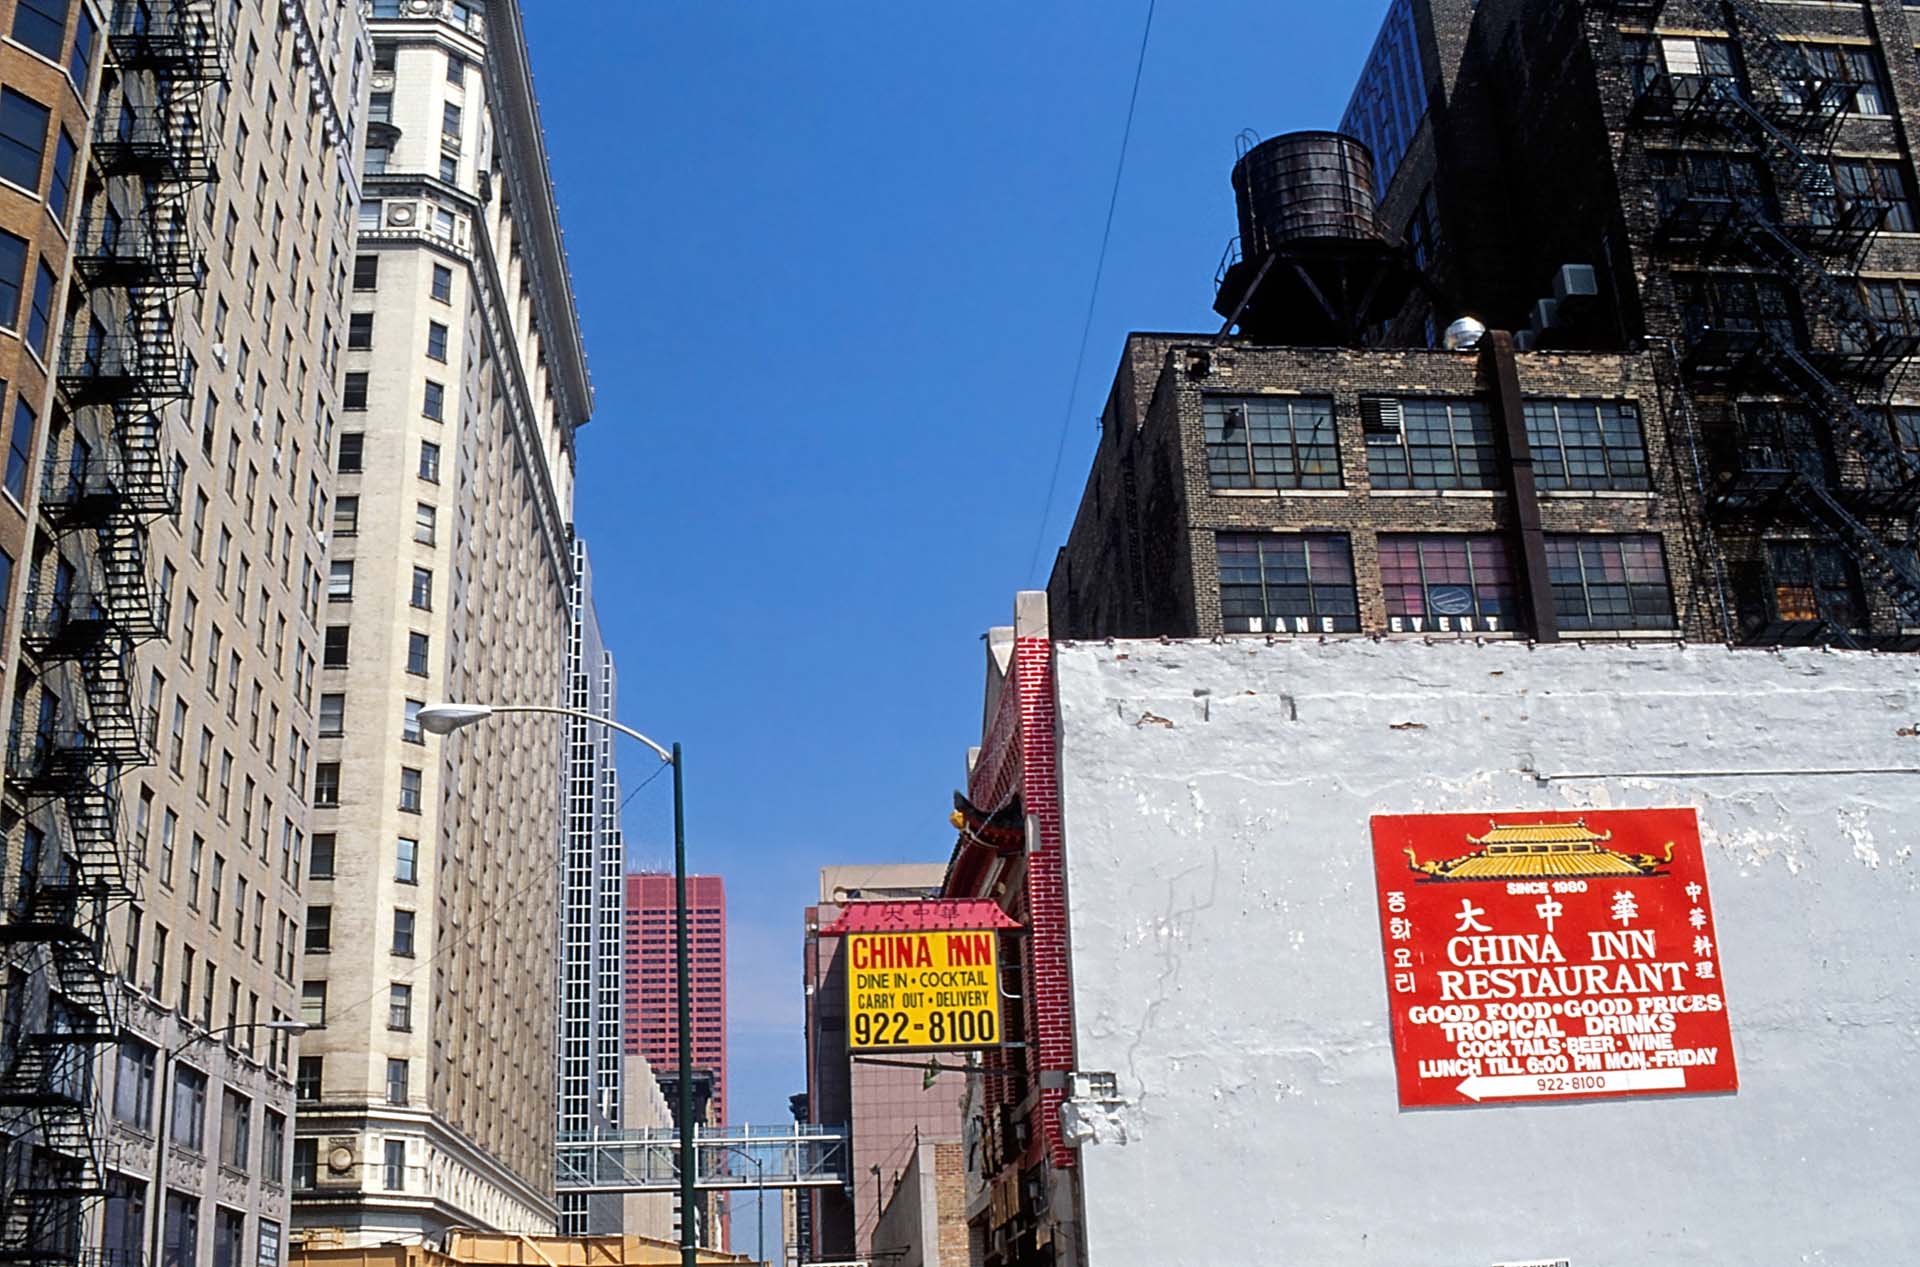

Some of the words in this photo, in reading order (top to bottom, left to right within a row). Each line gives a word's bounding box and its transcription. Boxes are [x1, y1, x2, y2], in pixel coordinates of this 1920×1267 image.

[1249, 617, 1334, 633] MANE
[1391, 616, 1499, 632] EVENT
[1507, 883, 1549, 895] SINCE
[1552, 881, 1588, 893] 1980
[852, 935, 933, 970] CHINA
[947, 934, 992, 967] INN
[1447, 934, 1566, 967] CHINA
[1588, 929, 1656, 961] INN
[857, 973, 889, 989] DINE
[894, 973, 908, 988] IN
[919, 970, 988, 988] COCKTAIL
[1437, 962, 1689, 1001] RESTAURANT
[858, 993, 895, 1009] CARRY
[902, 993, 925, 1008] OUT
[936, 991, 989, 1007] DELIVERY
[1408, 1005, 1480, 1024] GOOD
[1484, 1001, 1552, 1020] FOOD
[1563, 998, 1633, 1017] GOOD
[1636, 994, 1723, 1014] PRICES
[855, 1010, 995, 1045] 922-8100
[1439, 1018, 1566, 1042] TROPICAL
[1584, 1012, 1676, 1036] DRINKS
[1566, 1036, 1616, 1054] BEER
[1626, 1033, 1674, 1051] WINE
[1418, 1058, 1482, 1078] LUNCH
[1484, 1057, 1526, 1075] TILL
[1526, 1055, 1569, 1074] 6:00
[1574, 1053, 1602, 1071] PM
[1536, 1076, 1606, 1091] 922-8100
